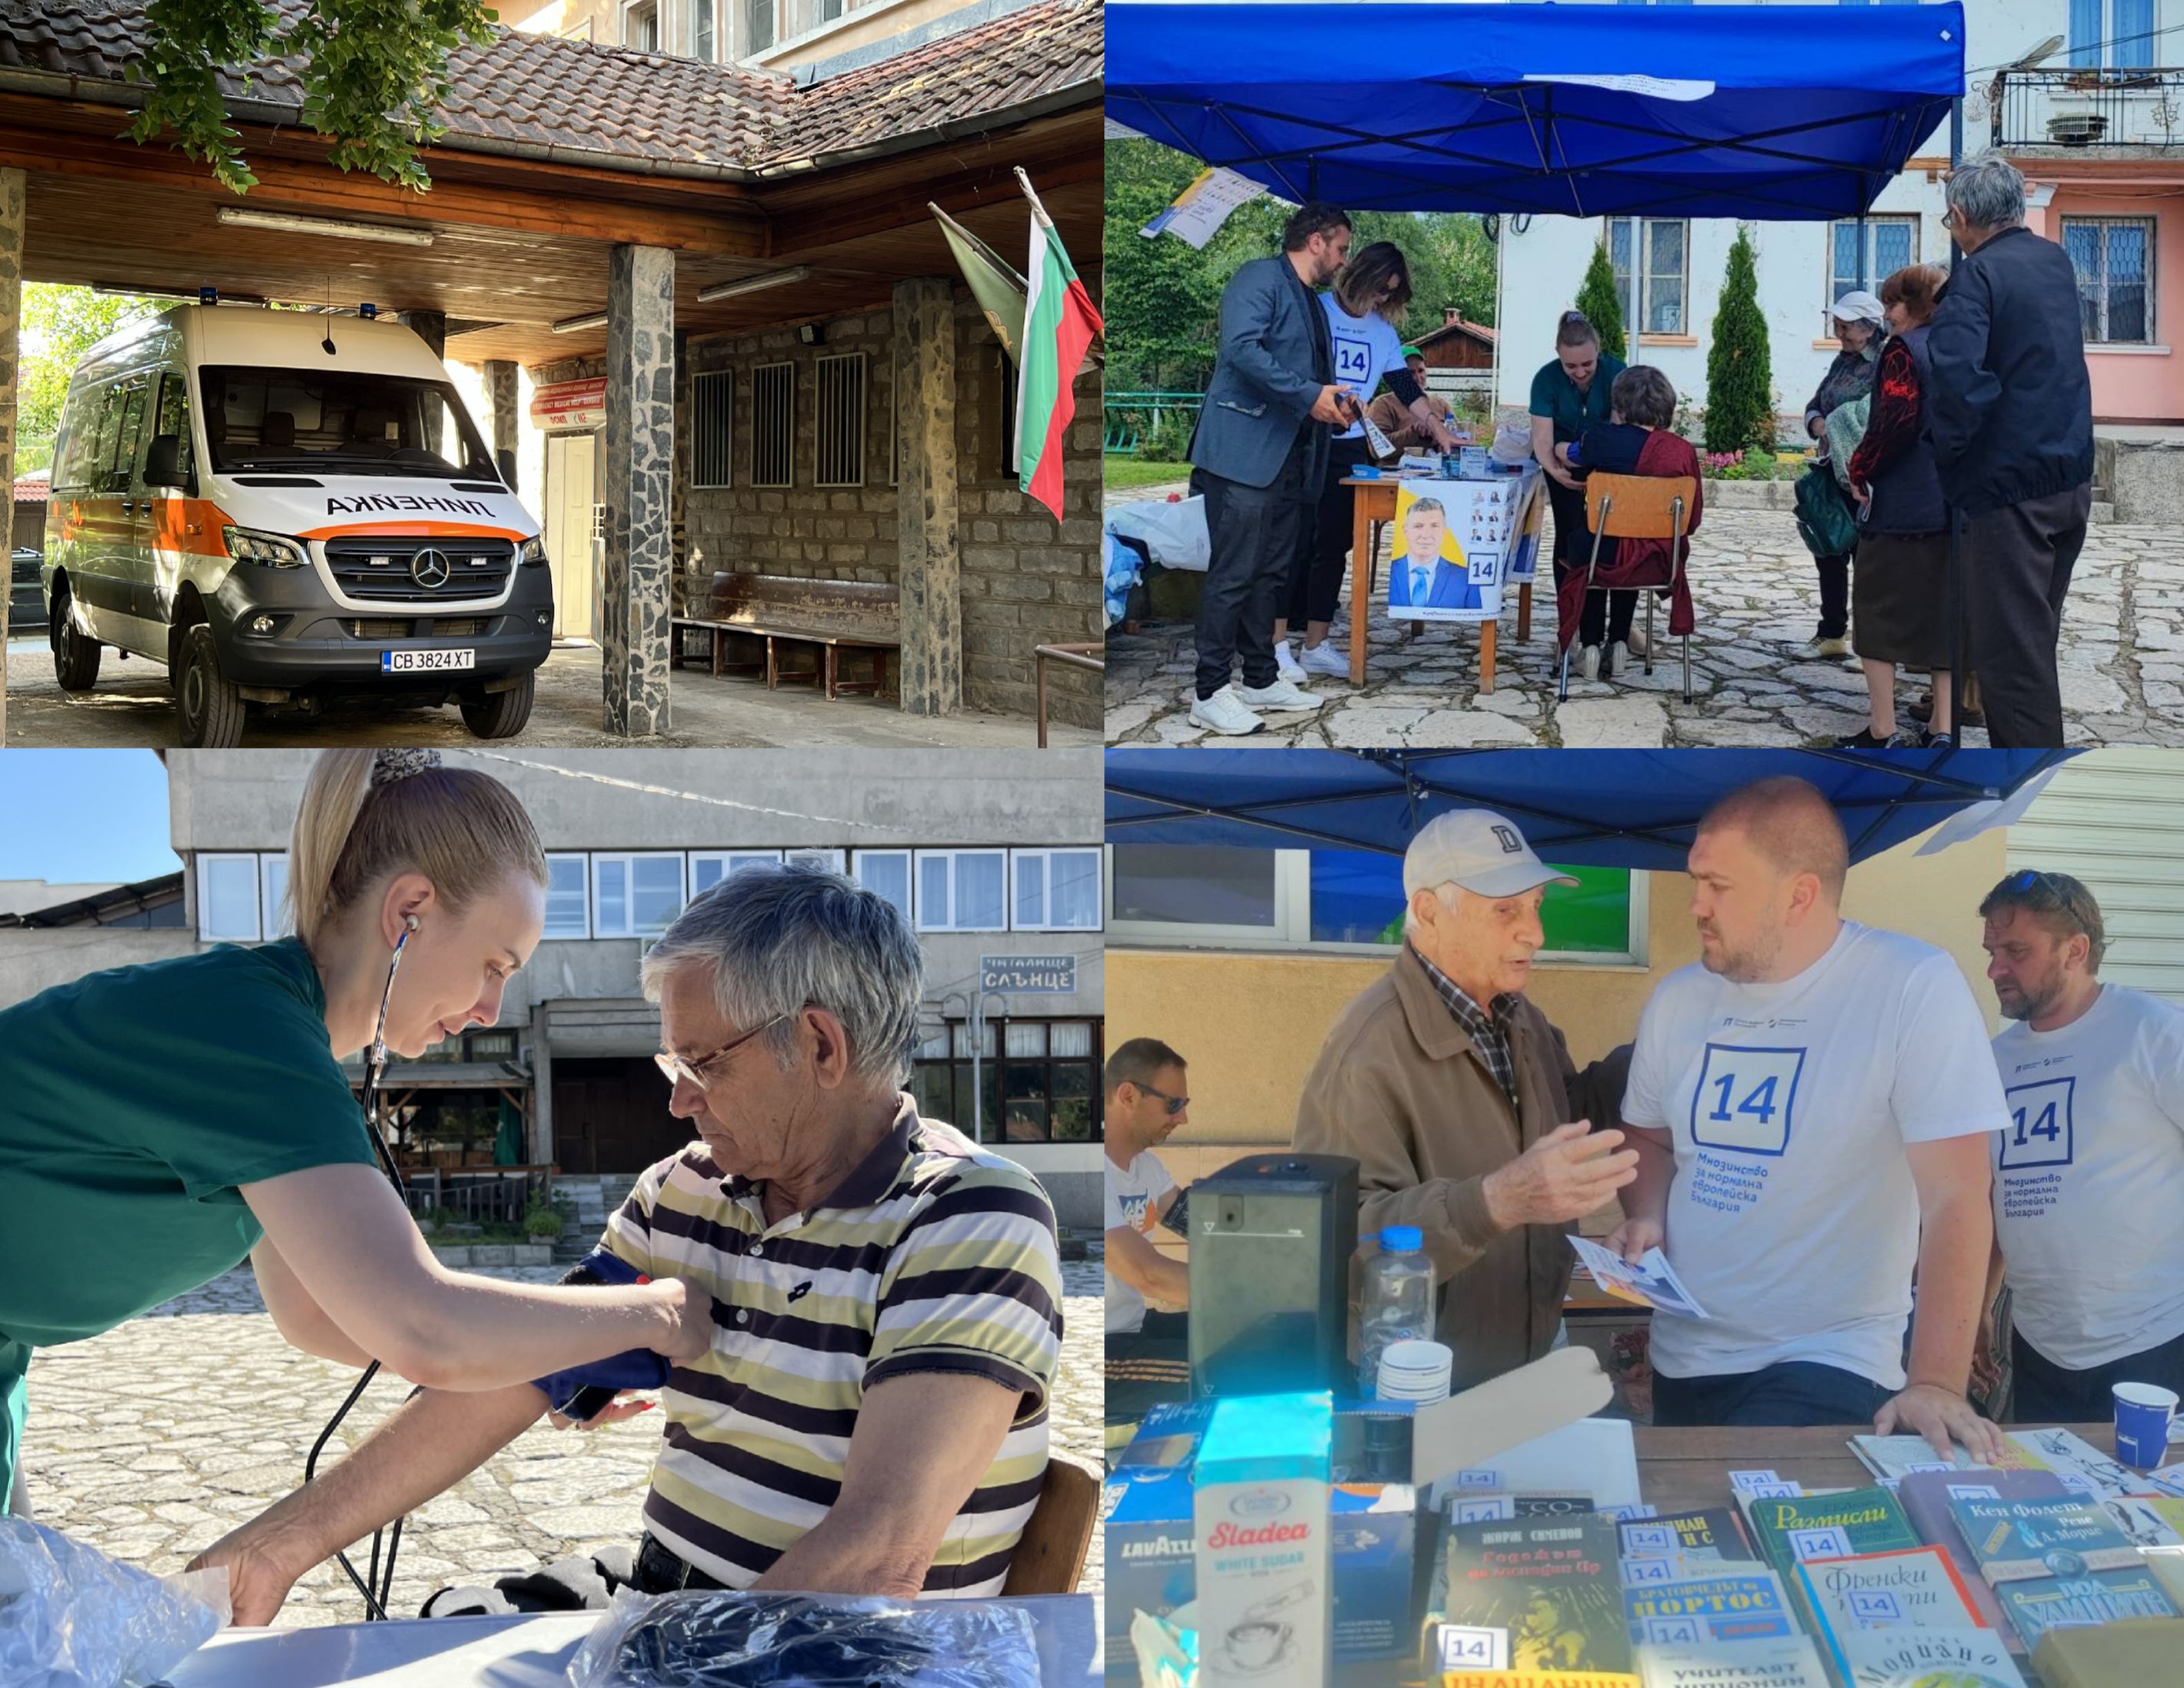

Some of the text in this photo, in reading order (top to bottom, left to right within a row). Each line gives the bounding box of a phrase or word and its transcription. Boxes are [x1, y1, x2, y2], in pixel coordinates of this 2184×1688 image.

[1340, 349, 1366, 371] 14
[1472, 562, 1492, 577] 14
[393, 653, 413, 669] CB
[416, 652, 451, 668] 3824
[454, 651, 472, 667] XT
[1490, 825, 1522, 854] D
[986, 959, 1069, 970] ЧИТАЛИЩЕ
[1709, 1073, 1778, 1124] 14
[2012, 1101, 2061, 1147] 14
[1696, 1153, 1768, 1178] Мнозинство
[1693, 1167, 1763, 1190] за нормална
[2004, 1173, 2061, 1188] Мнозинство
[1692, 1180, 1758, 1203] европейска
[2013, 1186, 2059, 1197] нормална
[1690, 1191, 1741, 1213] България
[2004, 1195, 2057, 1208] европейска
[2005, 1208, 2044, 1219] България
[1464, 1474, 1490, 1483] 14
[1465, 1509, 1495, 1523] 14
[1774, 1505, 1888, 1531] Размисли
[1970, 1502, 2083, 1519] Кен Фолет
[2058, 1515, 2094, 1528] Рене
[1208, 1522, 1311, 1549] Sladea
[1482, 1531, 1523, 1545] ЖОРЖ
[1636, 1533, 1661, 1543] 14
[2058, 1526, 2103, 1541] Морис
[1804, 1538, 1834, 1554] 14
[1214, 1551, 1304, 1571] WHITE SUGAR
[1634, 1567, 1663, 1580] 14
[1824, 1565, 1928, 1598] Френски
[1638, 1581, 1738, 1599] БРАТОВЧЕДЪТ
[2057, 1579, 2110, 1598] ПОД
[1633, 1591, 1773, 1617] ПОРТОС
[1859, 1598, 1890, 1611] 14
[1658, 1627, 1692, 1644] 14
[1452, 1639, 1486, 1658] 14
[1673, 1662, 1800, 1680] УЧИТЕЛЯТ
[1857, 1644, 1998, 1687] Модиано
